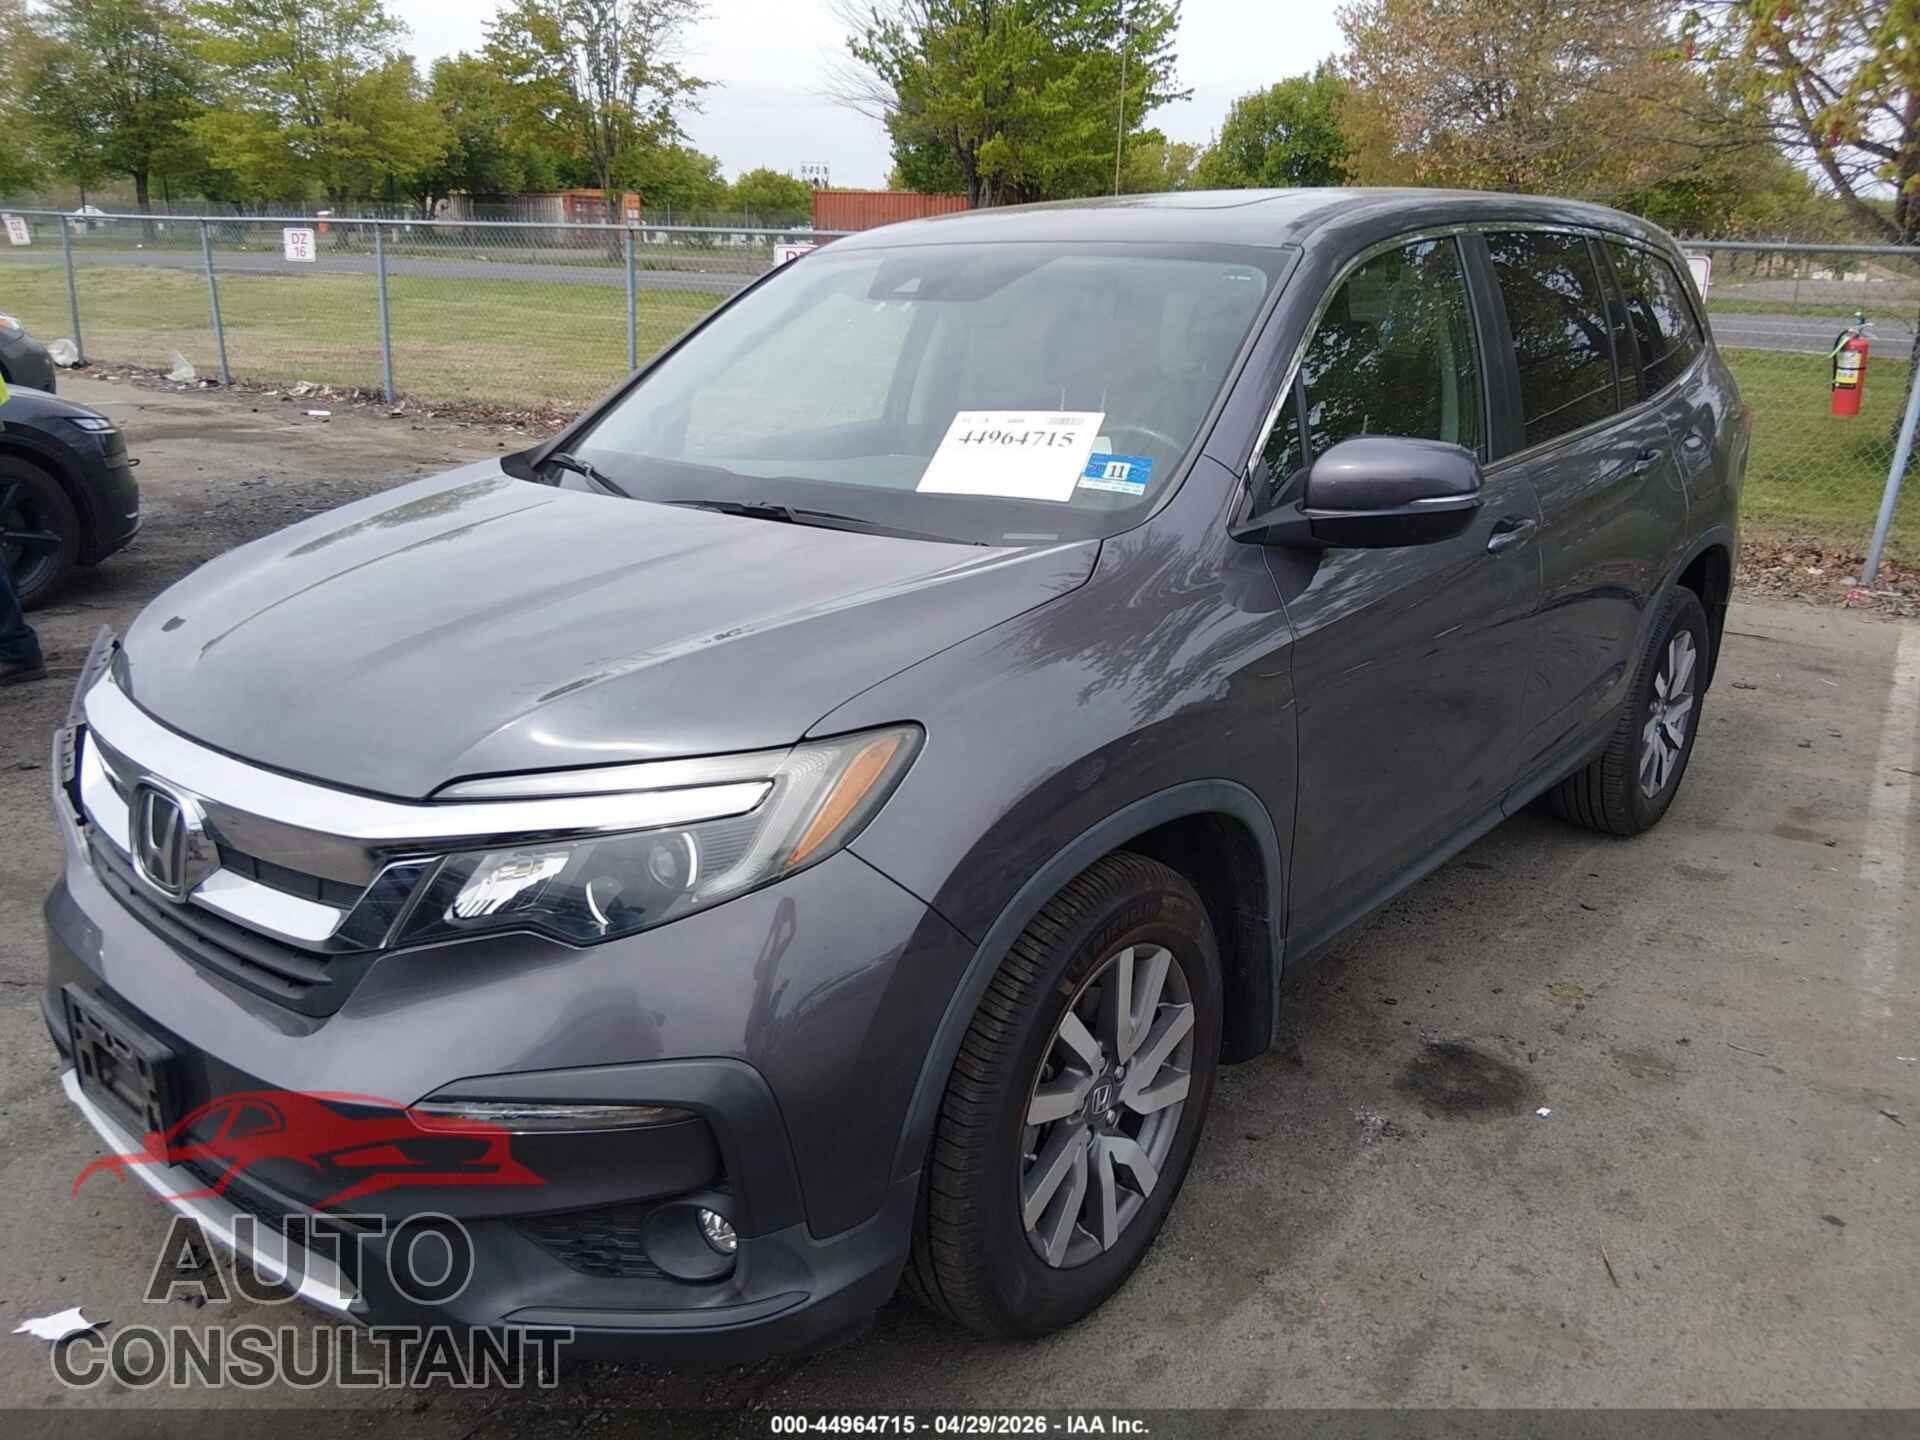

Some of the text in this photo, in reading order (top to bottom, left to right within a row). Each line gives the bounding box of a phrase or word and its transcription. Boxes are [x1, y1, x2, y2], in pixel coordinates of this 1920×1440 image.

[291, 232, 308, 245] DZ
[294, 246, 306, 257] 16
[958, 429, 1076, 447] 44964715
[1109, 464, 1125, 478] 11
